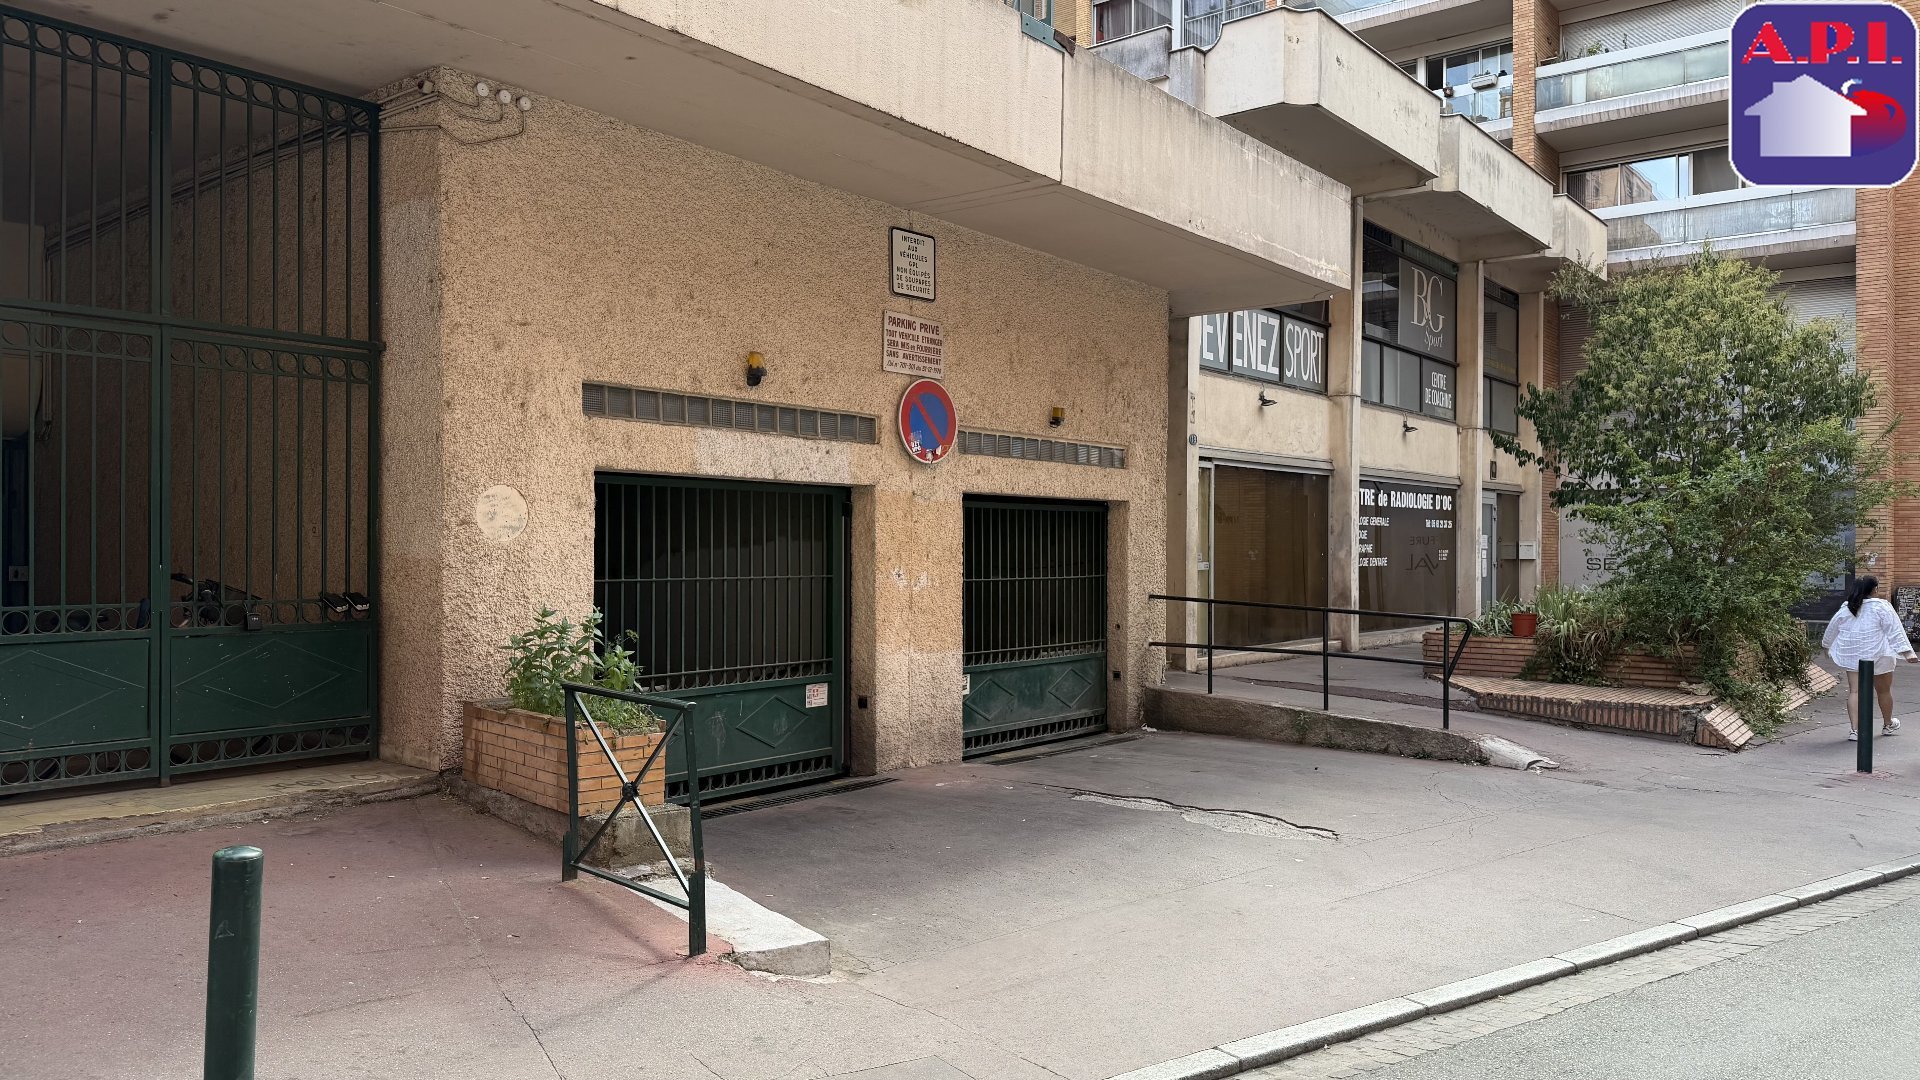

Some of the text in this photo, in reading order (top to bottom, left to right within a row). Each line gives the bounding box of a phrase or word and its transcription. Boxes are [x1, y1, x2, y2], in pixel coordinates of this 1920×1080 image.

[901, 235, 925, 246] INTERDIT
[908, 244, 918, 252] AUX
[899, 250, 928, 263] VÉHICULES
[896, 266, 908, 275] NON
[908, 260, 919, 269] GPL
[896, 273, 931, 287] DE SOUPAPES
[897, 282, 904, 290] DE
[887, 315, 917, 331] PARKING
[885, 328, 898, 338] TOUT
[1424, 325, 1443, 351] Sport
[886, 338, 899, 348] SERA
[900, 341, 910, 350] MIS
[1200, 310, 1324, 384] EVENEZ SPORT
[886, 349, 942, 366] SANS AVERTISSEMENT
[1431, 371, 1447, 390] CENTRE
[1425, 387, 1452, 409] DE COACHING
[1378, 489, 1388, 507] de
[1390, 490, 1433, 510] RADIOLOGIE
[1435, 494, 1452, 511] D'OC
